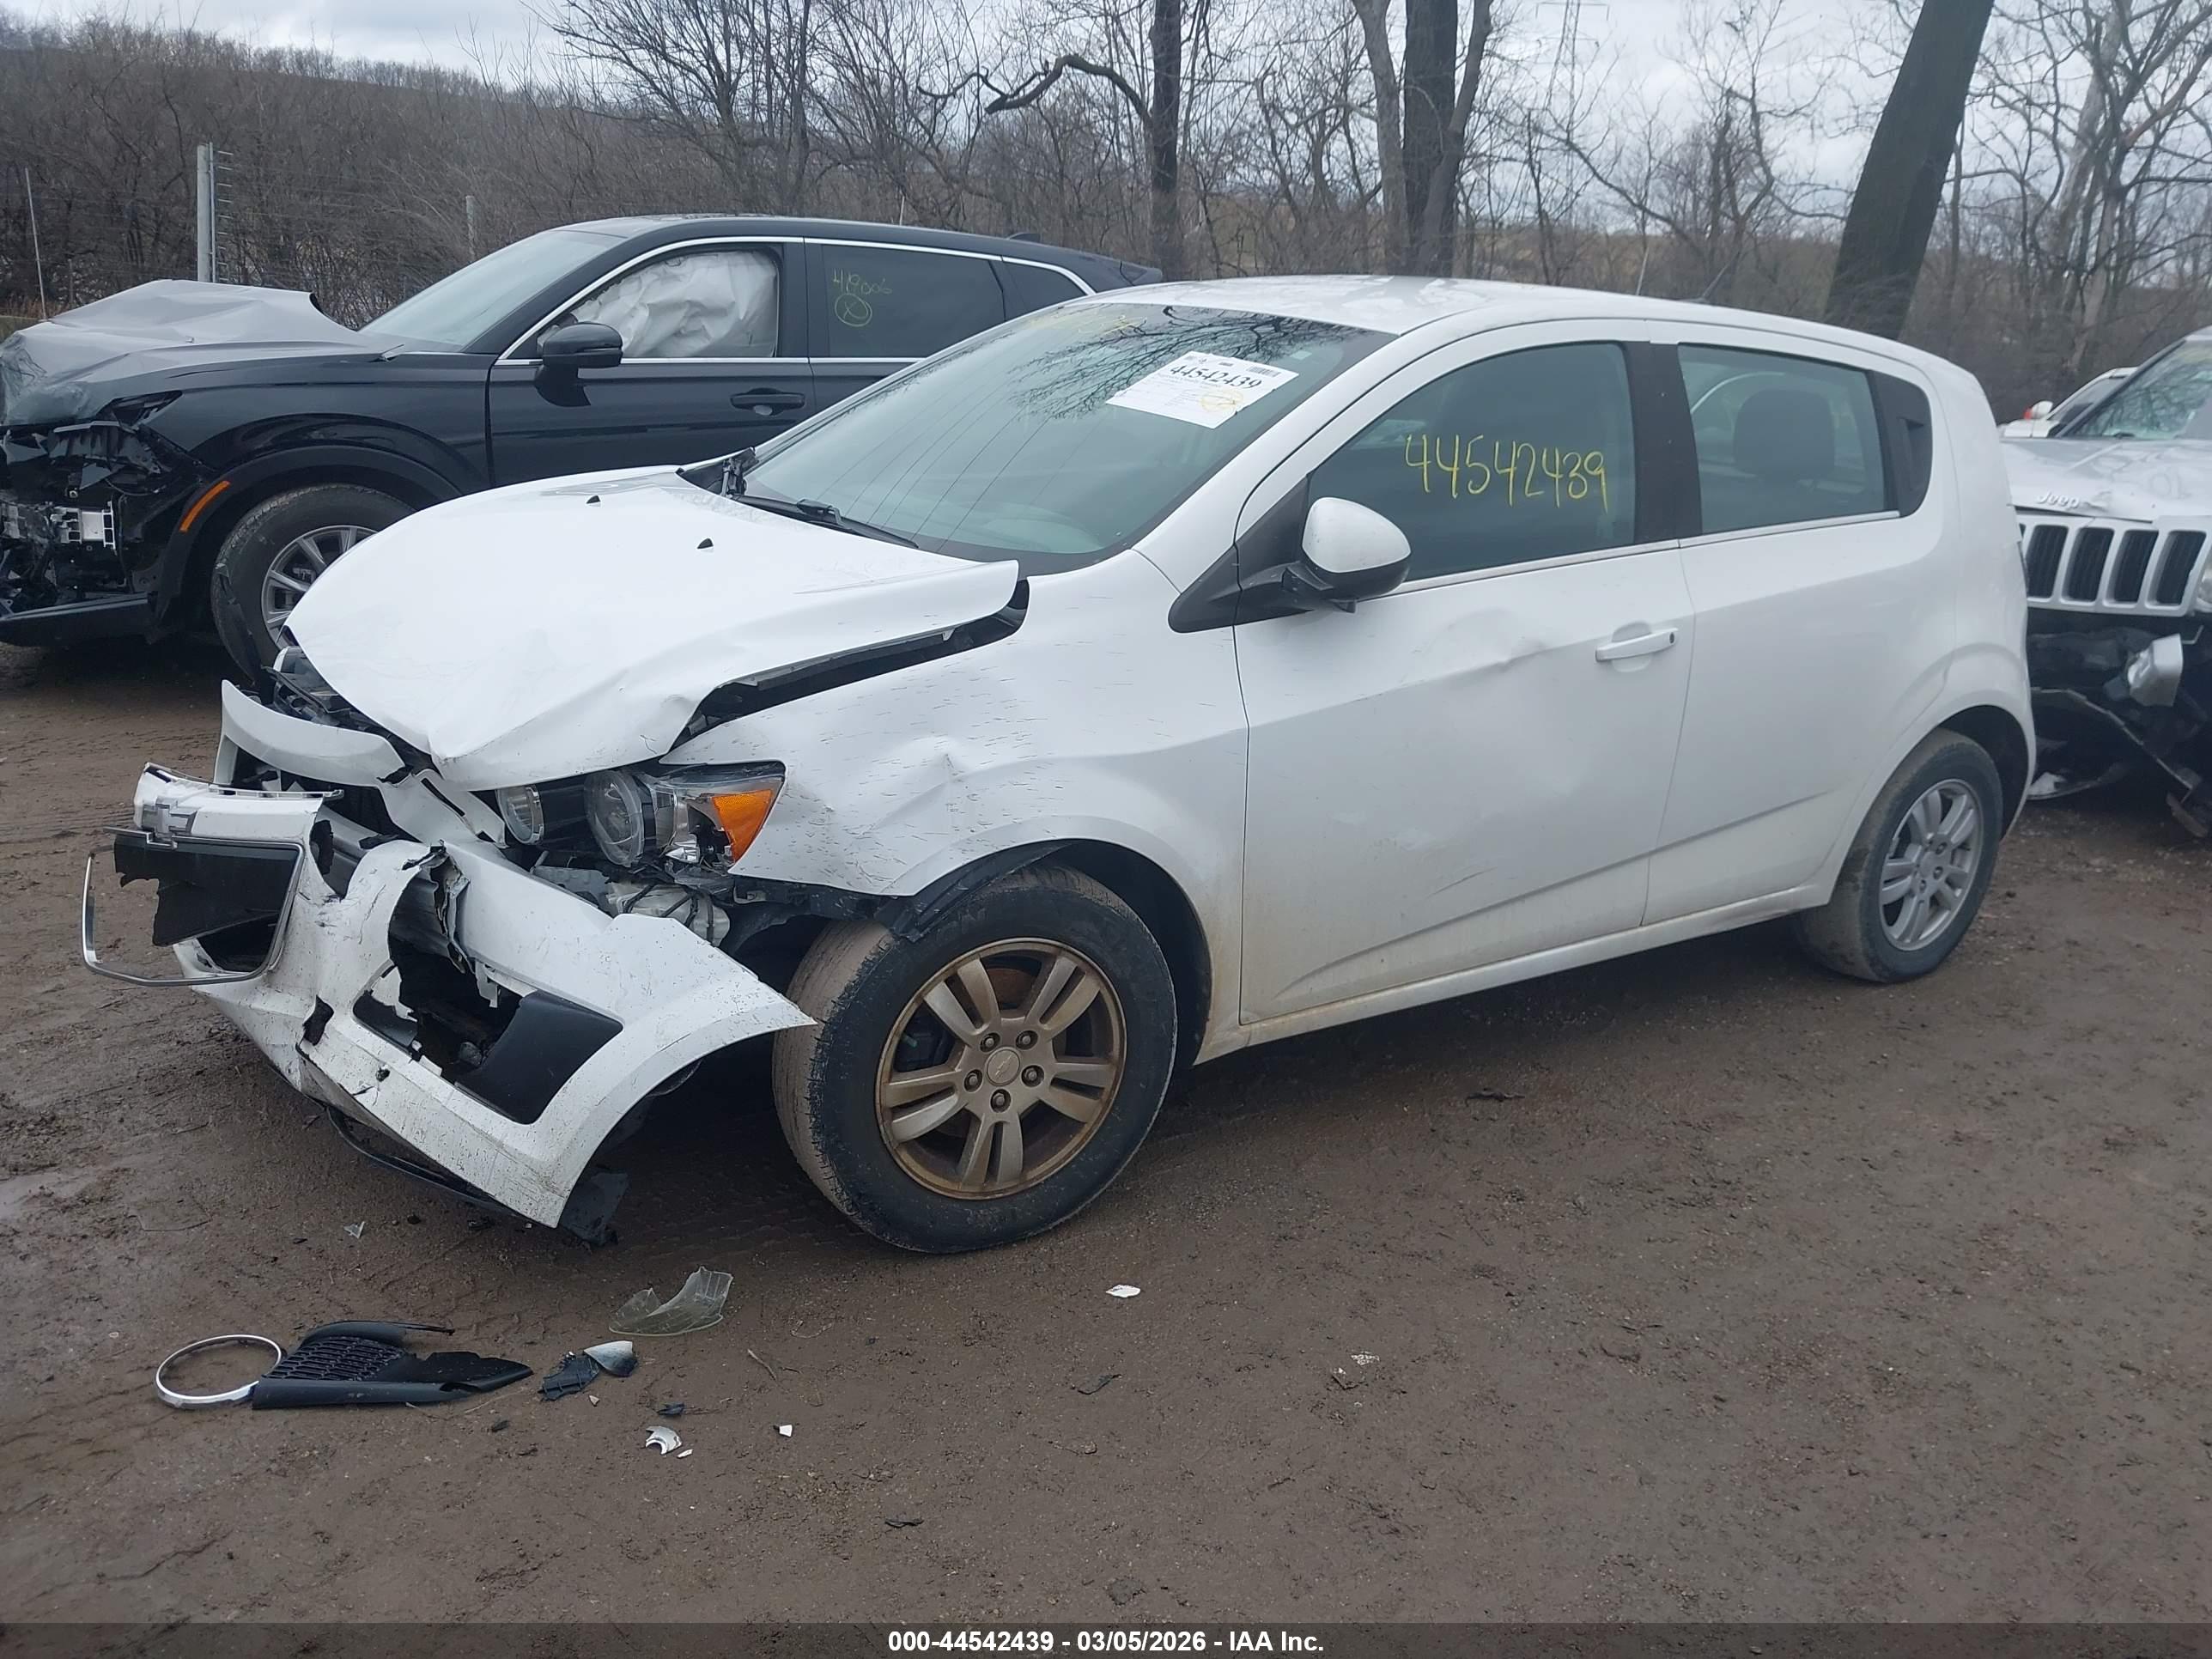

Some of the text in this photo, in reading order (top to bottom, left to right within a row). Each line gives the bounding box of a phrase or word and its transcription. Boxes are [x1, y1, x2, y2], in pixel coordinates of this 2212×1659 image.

[1170, 364, 1262, 389] 44542439
[1405, 433, 1609, 514] 44542439
[2036, 491, 2081, 509] Jeep
